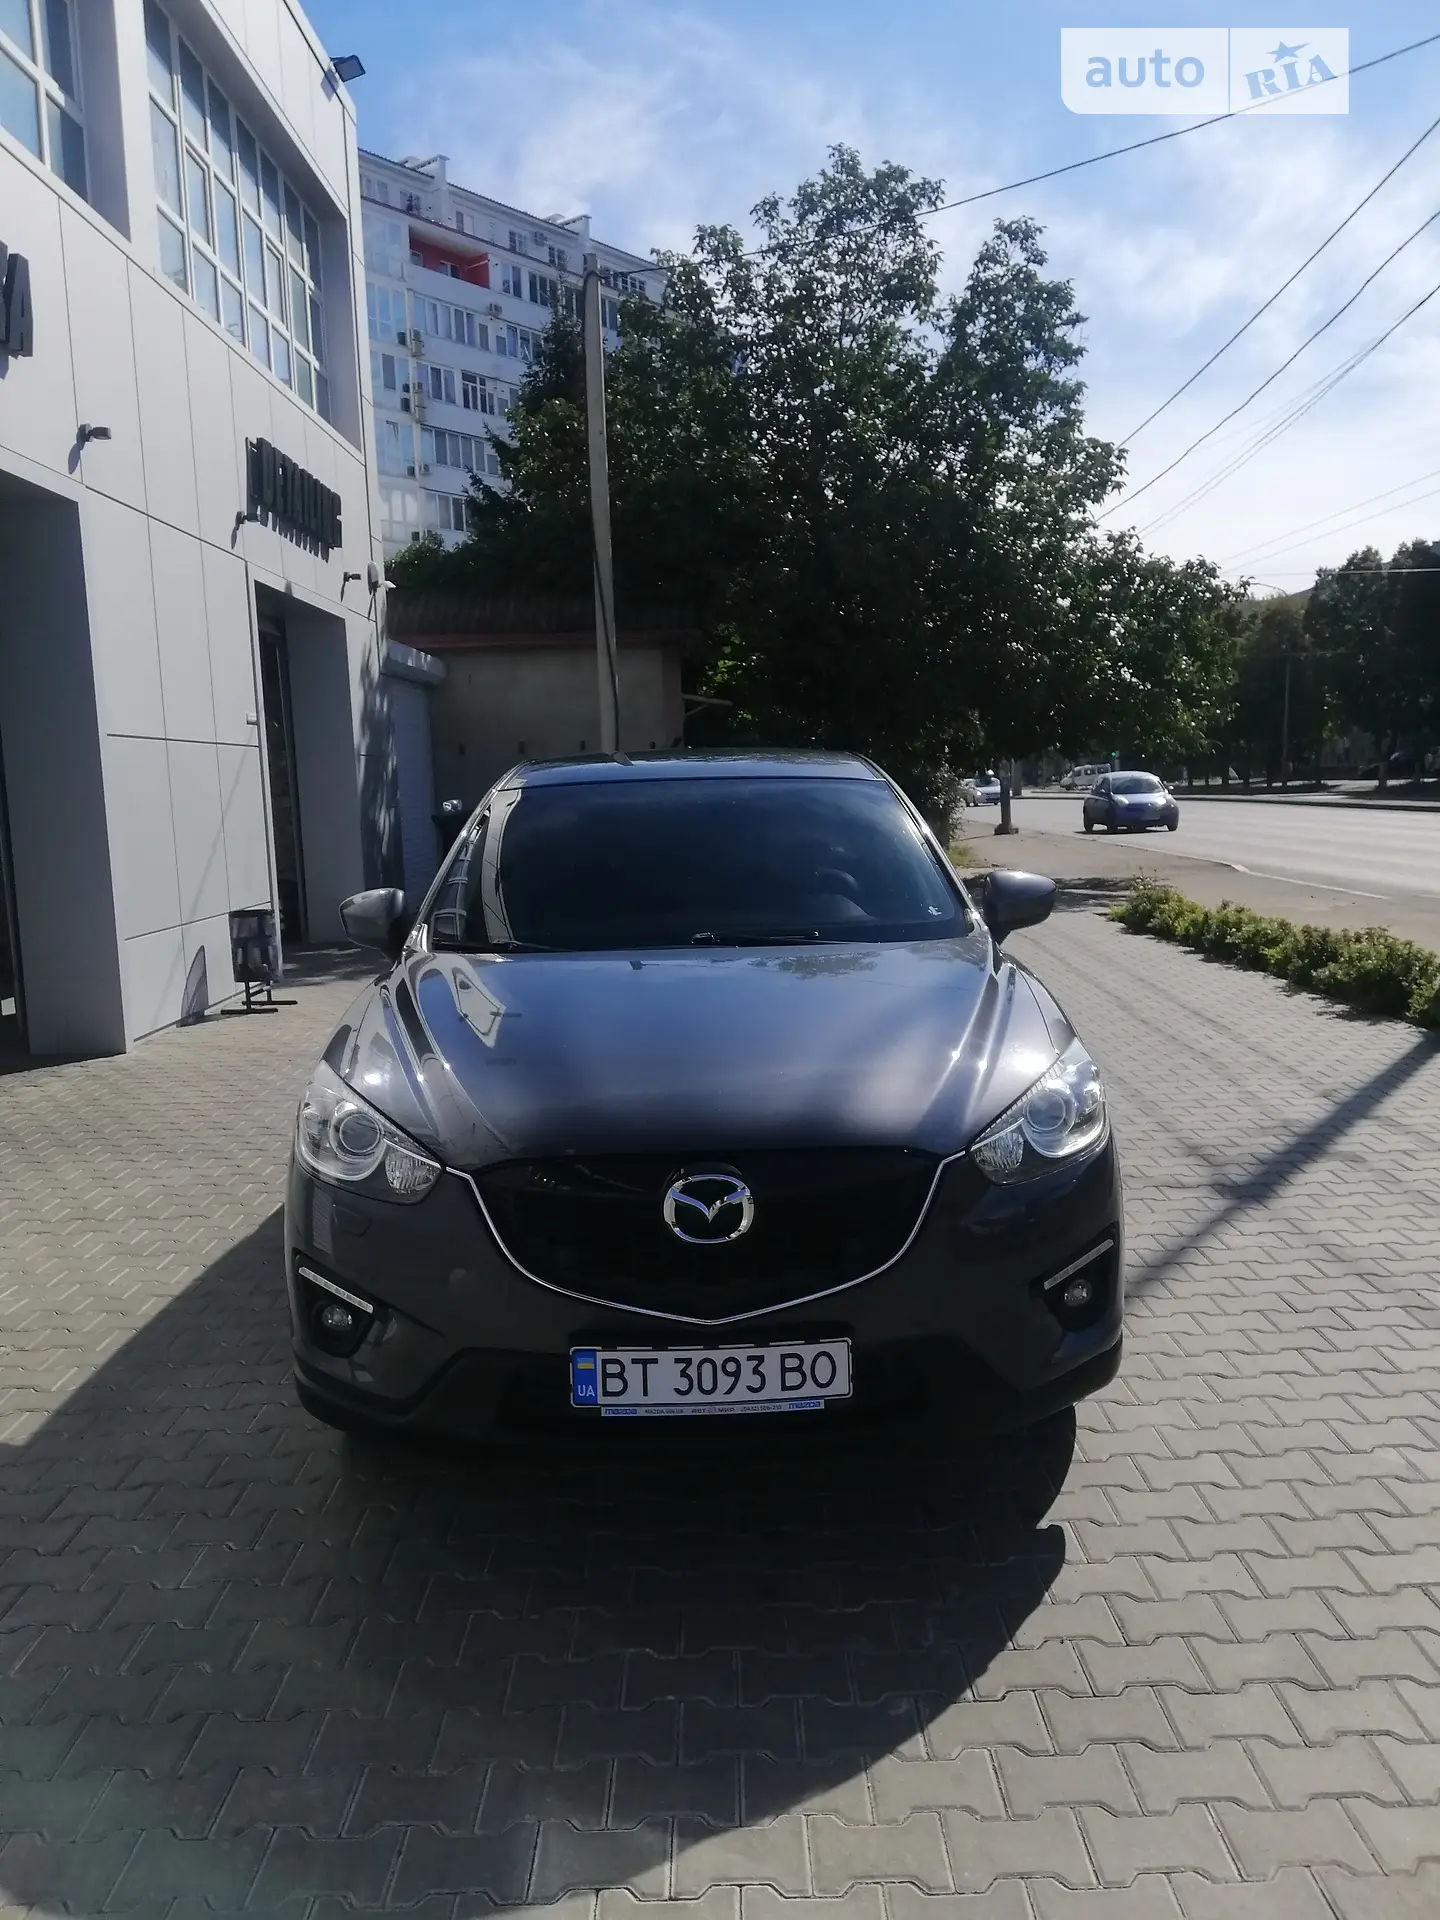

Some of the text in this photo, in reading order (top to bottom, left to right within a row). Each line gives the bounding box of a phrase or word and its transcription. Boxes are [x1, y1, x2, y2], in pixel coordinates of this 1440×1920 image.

[601, 1350, 837, 1397] BT 3093 BO
[578, 1384, 596, 1398] UA
[788, 1400, 821, 1409] mazda
